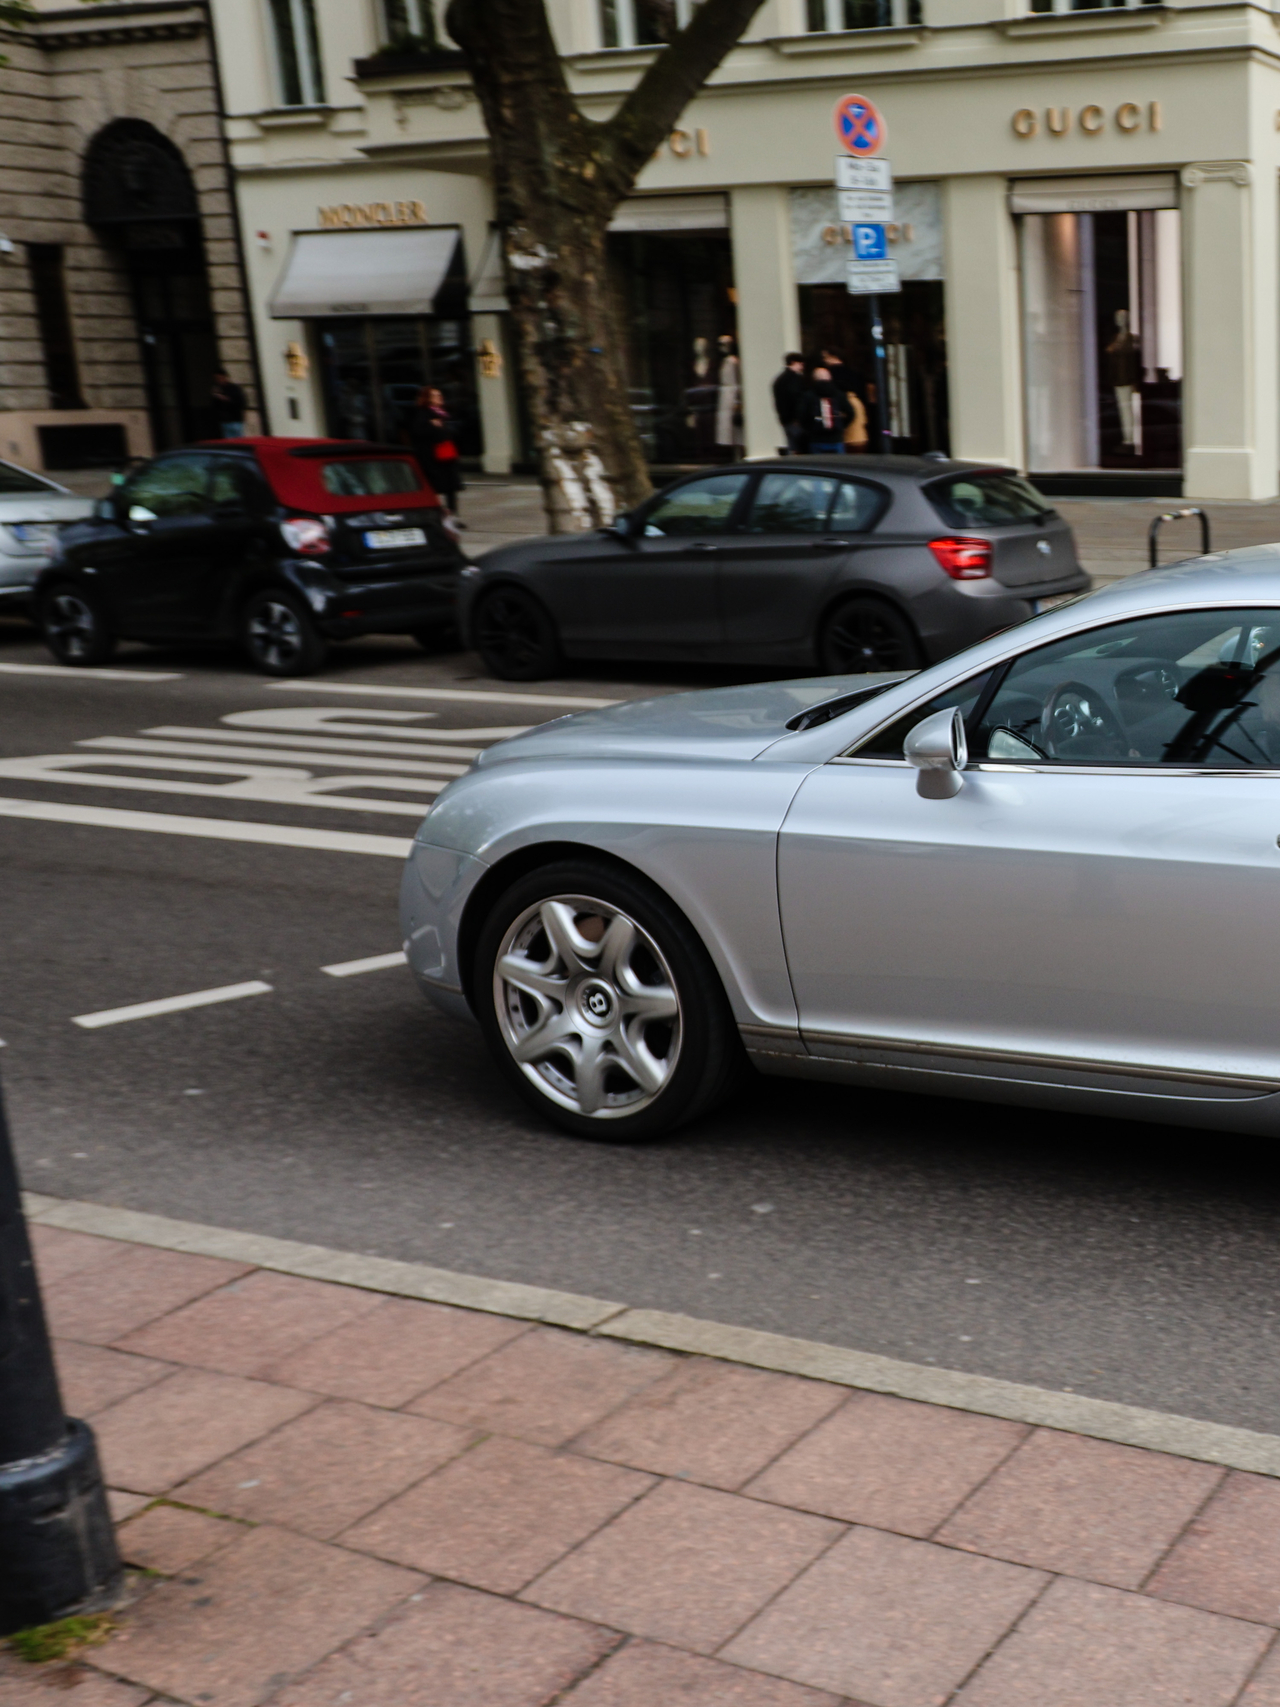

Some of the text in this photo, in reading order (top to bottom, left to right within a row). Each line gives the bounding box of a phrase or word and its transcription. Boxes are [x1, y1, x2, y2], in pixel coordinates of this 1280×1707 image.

[1013, 101, 1163, 138] GUCCI
[318, 200, 427, 228] MONCLER
[857, 227, 877, 255] P
